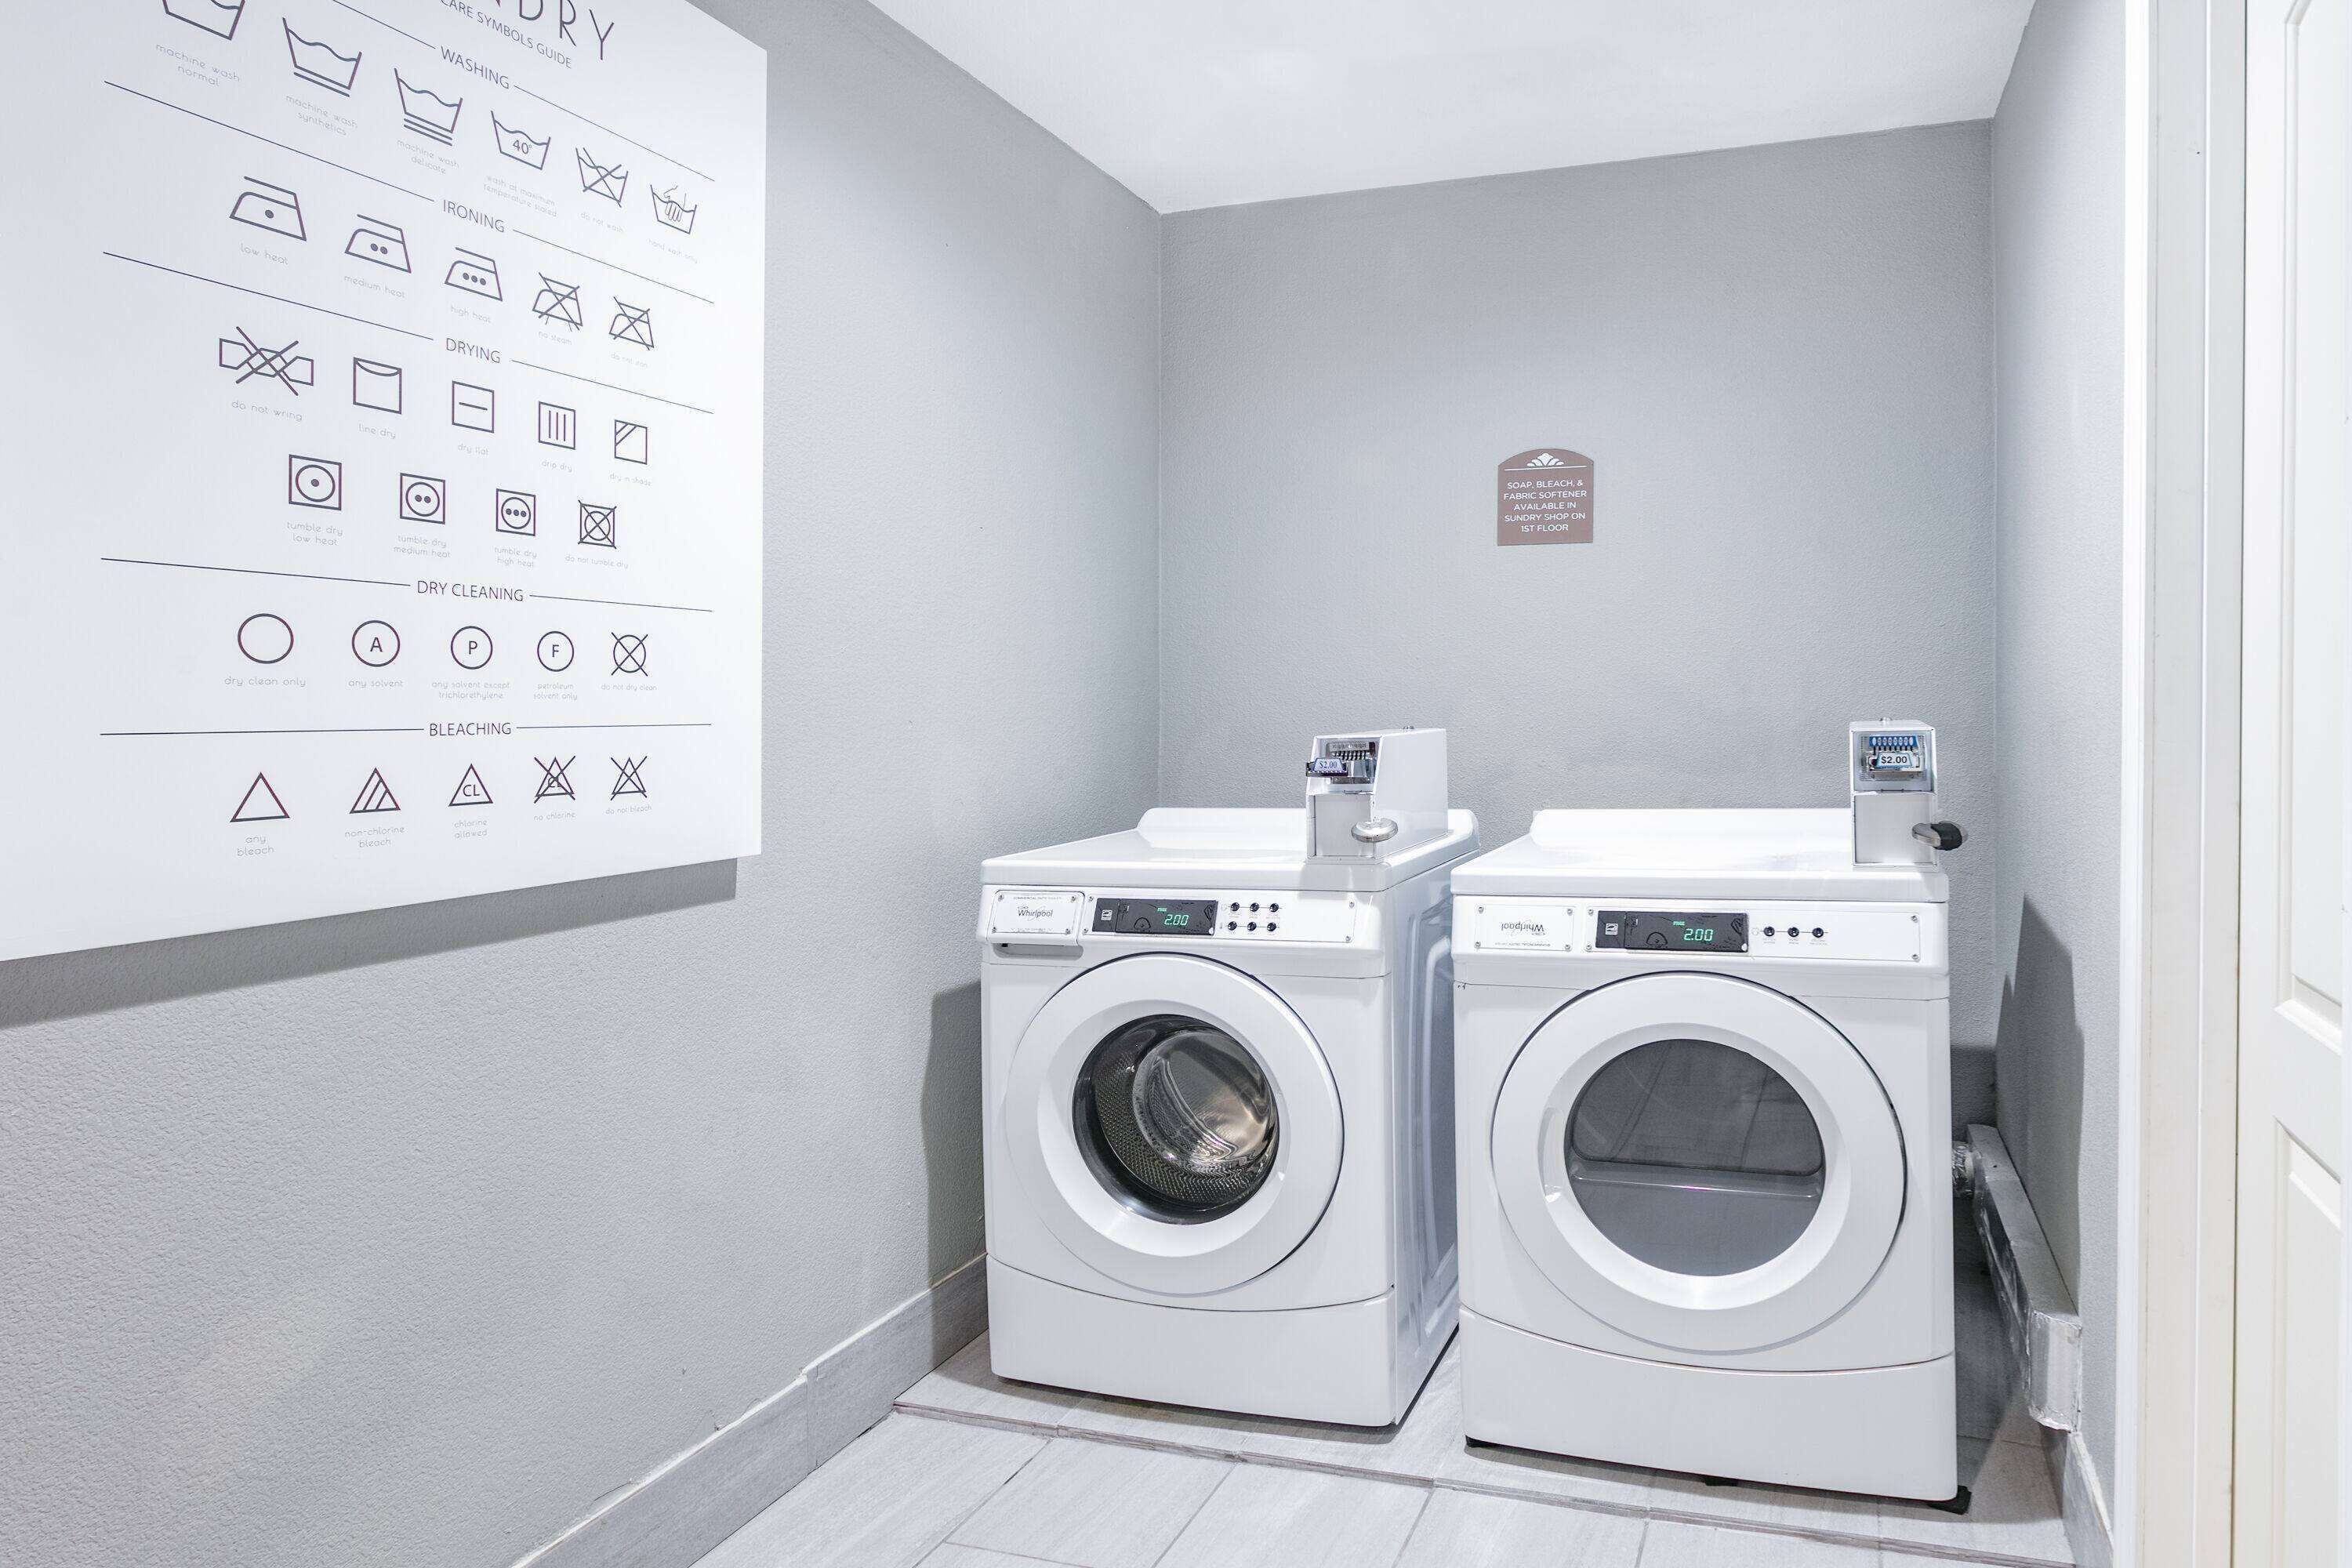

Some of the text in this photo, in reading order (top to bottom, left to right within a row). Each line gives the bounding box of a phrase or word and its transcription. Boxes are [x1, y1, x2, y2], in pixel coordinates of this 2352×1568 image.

[495, 0, 614, 60] RY
[477, 11, 534, 49] SYMBOLS
[536, 42, 572, 69] GUIDE
[156, 44, 241, 82] machine wash
[440, 45, 510, 89] WASHING
[177, 65, 220, 87] normal
[285, 94, 358, 129] machine wash
[297, 111, 347, 136] synthetics
[442, 199, 506, 233] IRONING
[240, 242, 289, 266] low heat
[344, 276, 406, 299] medium heat
[445, 337, 501, 364] DRYING
[231, 400, 303, 423] do not wring
[358, 423, 396, 440] line dry
[1507, 481, 1534, 490] SOAP,
[1536, 480, 1575, 489] BLEACH,
[1504, 490, 1587, 500] FABRIC SOFTENER
[1513, 502, 1565, 511] AVAILABLE
[1504, 514, 1542, 522] SUNDRY
[1544, 513, 1570, 521] SHOP
[286, 521, 343, 536] tumble dry
[1521, 524, 1569, 533] 1ST FLOOR
[292, 533, 339, 546] low heat
[431, 538, 447, 549] dry
[393, 546, 451, 558] medium heat
[417, 580, 524, 602] DRY CLEANING
[369, 636, 383, 653] A
[468, 640, 478, 655] P
[551, 644, 560, 658] F
[223, 675, 307, 688] dry clean only
[348, 678, 405, 689] any solvent
[429, 722, 512, 737] BLEACHING
[1319, 760, 1338, 769] $2.00
[1881, 756, 1907, 764] $2.00
[463, 784, 481, 798] CL
[344, 826, 405, 838] non-chlorine
[245, 835, 267, 845] any
[359, 837, 392, 848] bleach
[237, 845, 275, 857] bleach
[1018, 909, 1054, 919] Whirlpool
[1164, 913, 1189, 926] 2.00
[1500, 920, 1545, 932] Whirlpool
[1683, 927, 1714, 942] 2.00
